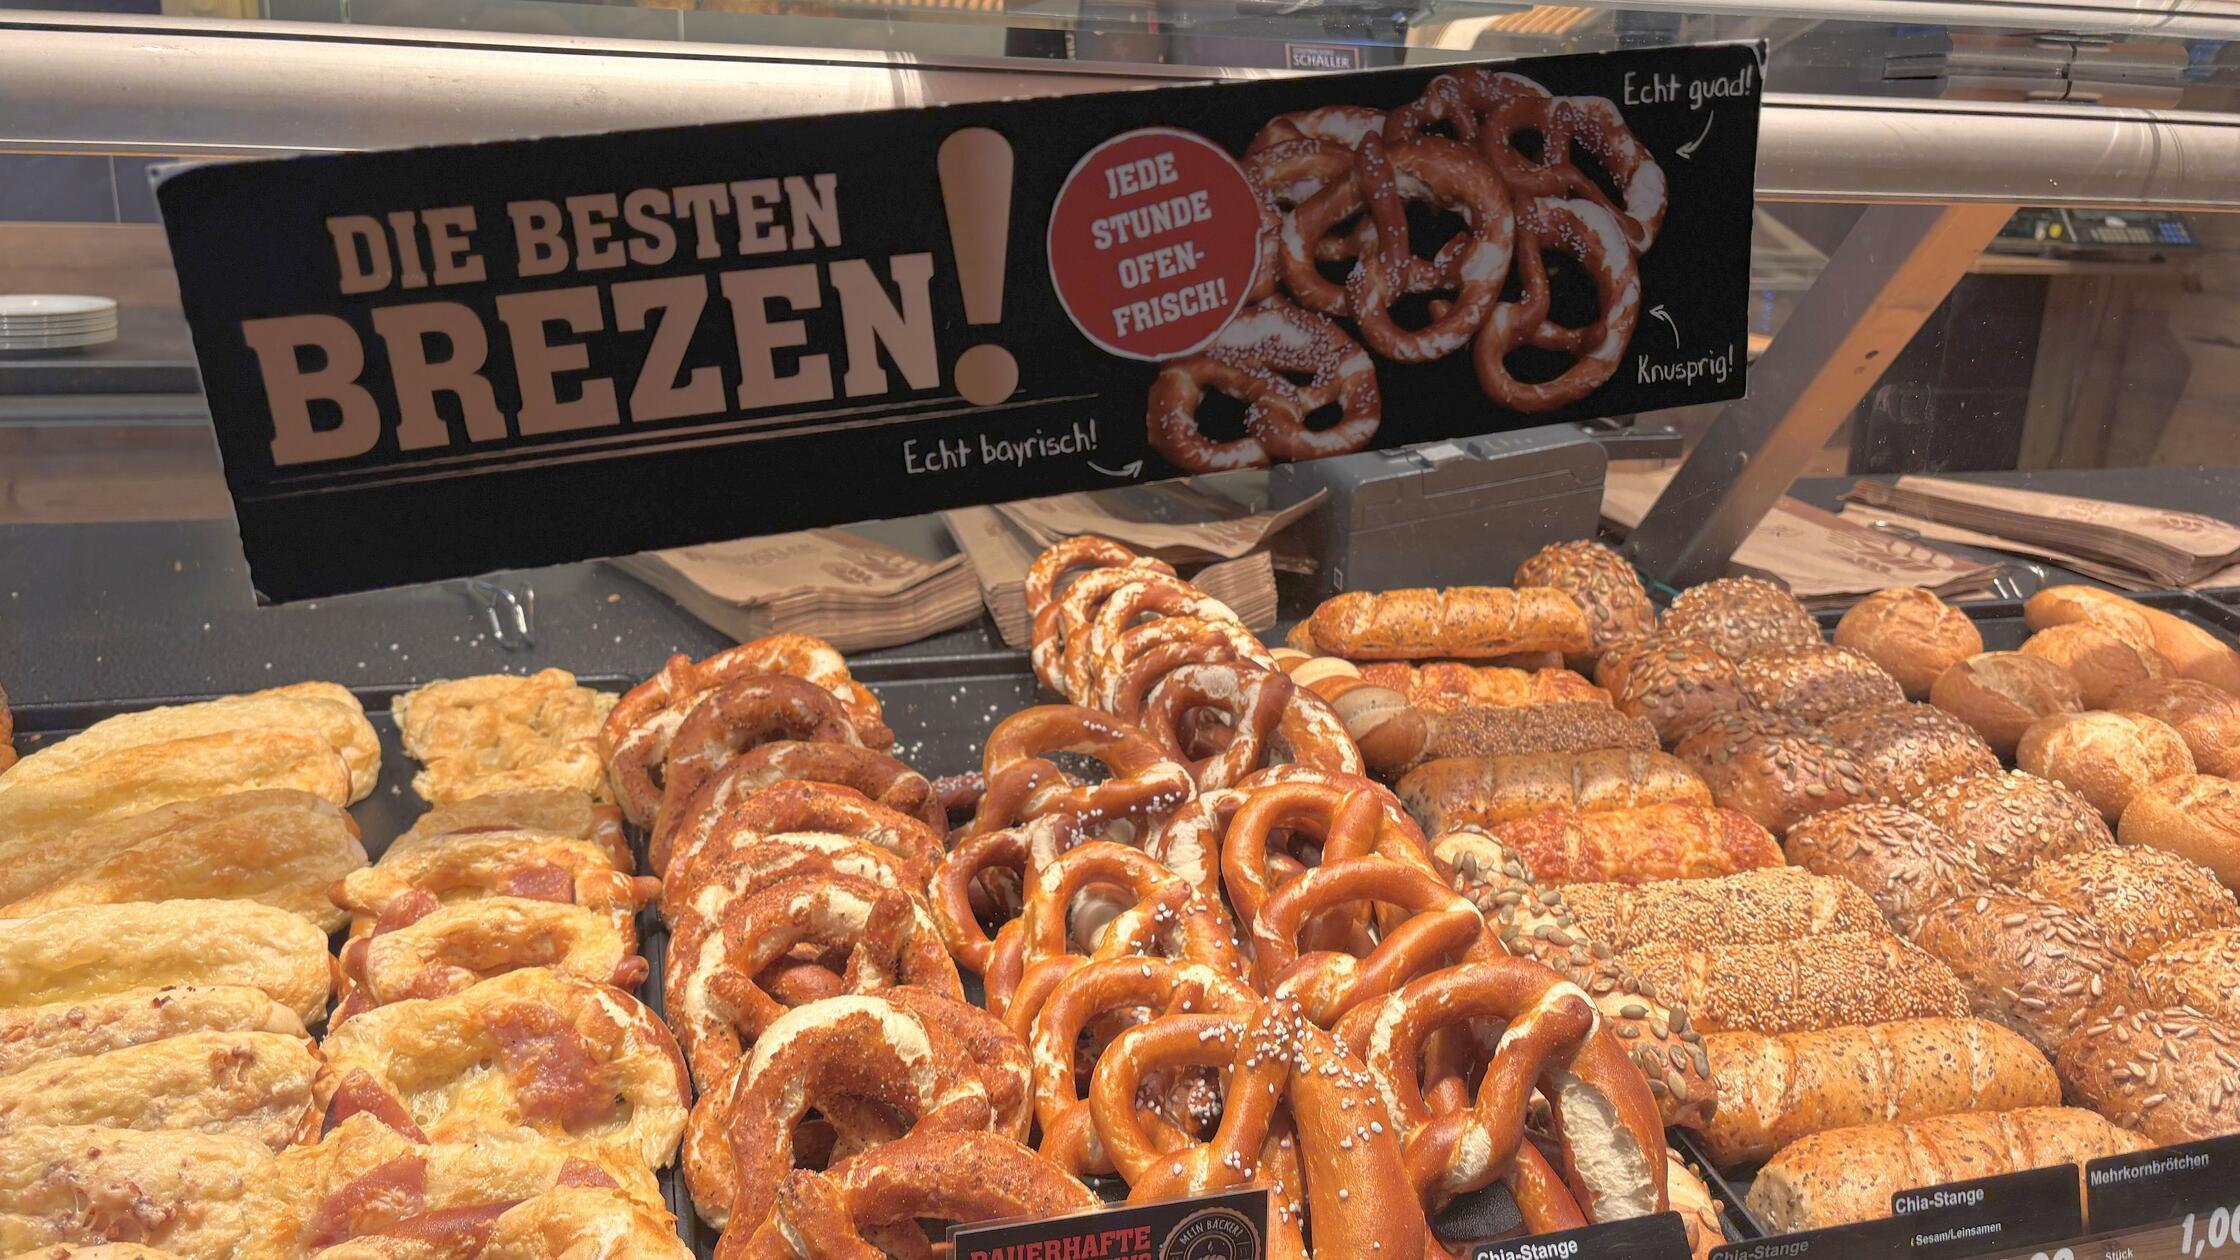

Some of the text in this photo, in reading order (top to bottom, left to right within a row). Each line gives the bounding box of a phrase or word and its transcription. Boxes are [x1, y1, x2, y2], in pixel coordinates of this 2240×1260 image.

[1623, 64, 1753, 110] Echt guad!
[1105, 152, 1179, 200] JEDE
[326, 173, 842, 294] DIE BESTEN
[1091, 190, 1213, 250] STUNDE
[1118, 241, 1206, 289] OFEN-
[241, 127, 1020, 466] BREZEN!
[1112, 277, 1229, 338] FRISCH!
[1637, 342, 1734, 387] Knusprig!
[903, 417, 1099, 474] Echt bayrisch!
[2090, 1153, 2209, 1187] Mehrkornbrötchen
[1895, 1188, 1985, 1214] Chia-Stange
[1179, 1222, 1204, 1245] MEIN
[1915, 1222, 2002, 1247] Sesam/Leinsamen
